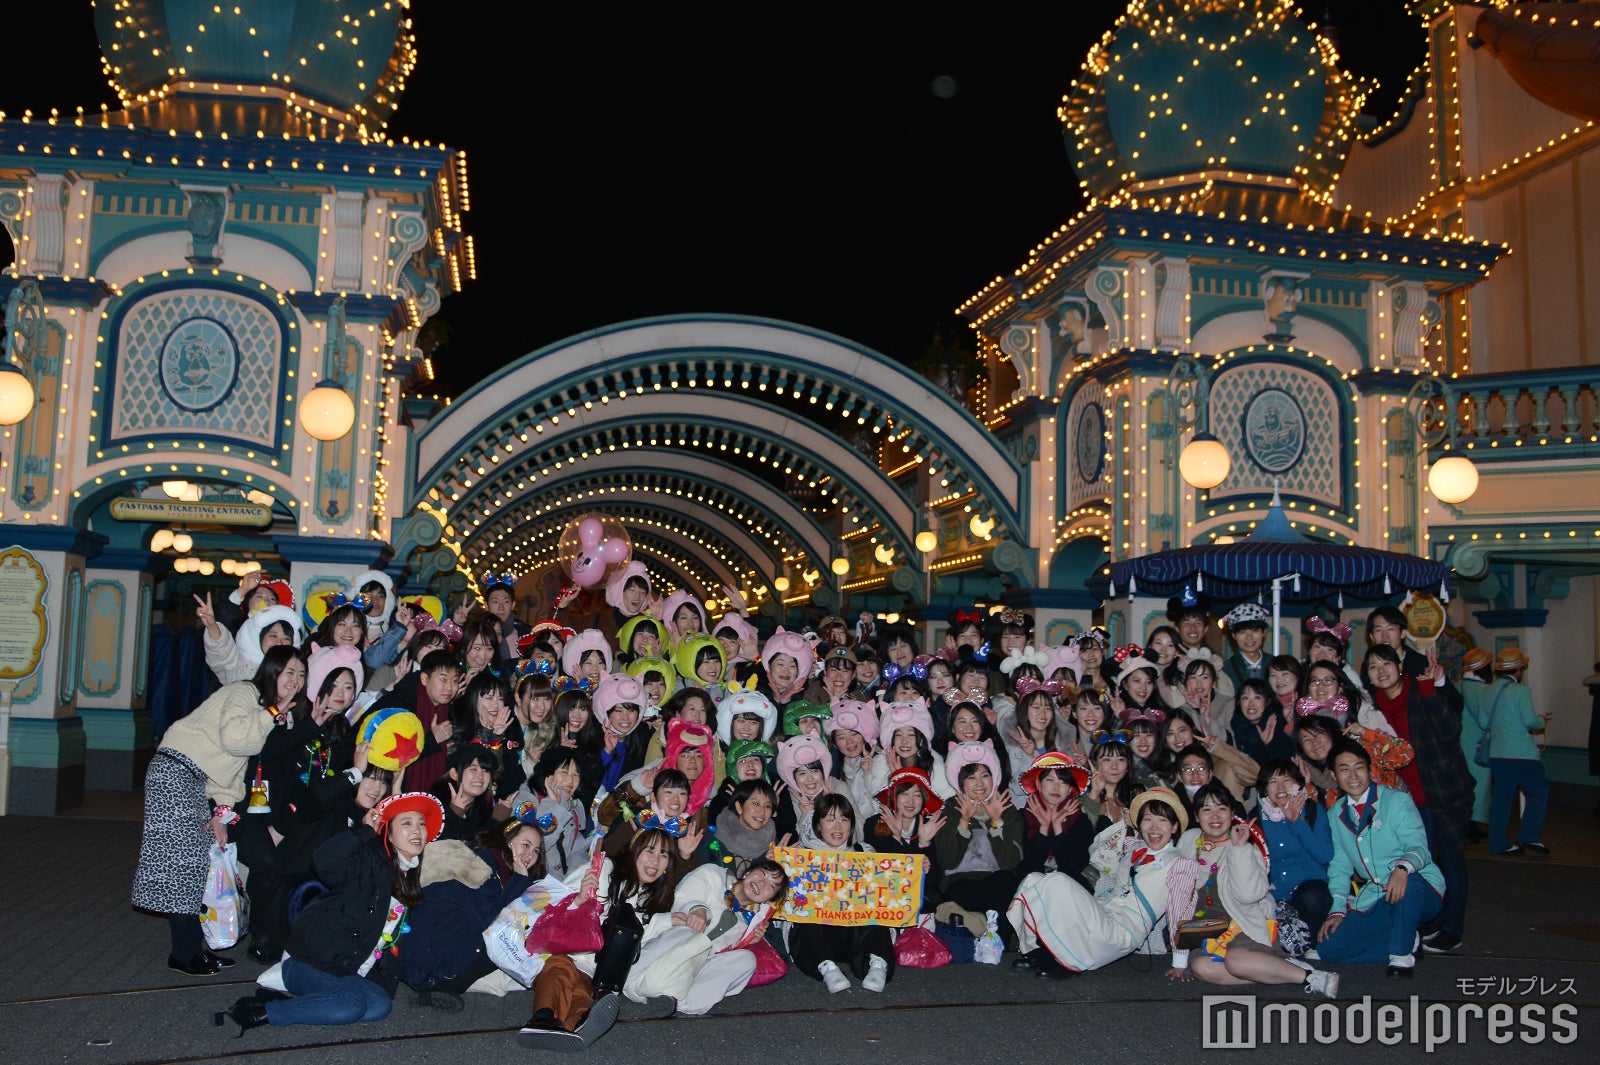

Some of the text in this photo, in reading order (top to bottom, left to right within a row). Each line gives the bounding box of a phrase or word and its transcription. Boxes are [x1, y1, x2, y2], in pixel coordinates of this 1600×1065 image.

[120, 502, 262, 515] FASTPASS TICKETING ENTRANCE
[814, 907, 905, 921] THANKS DAY 2020
